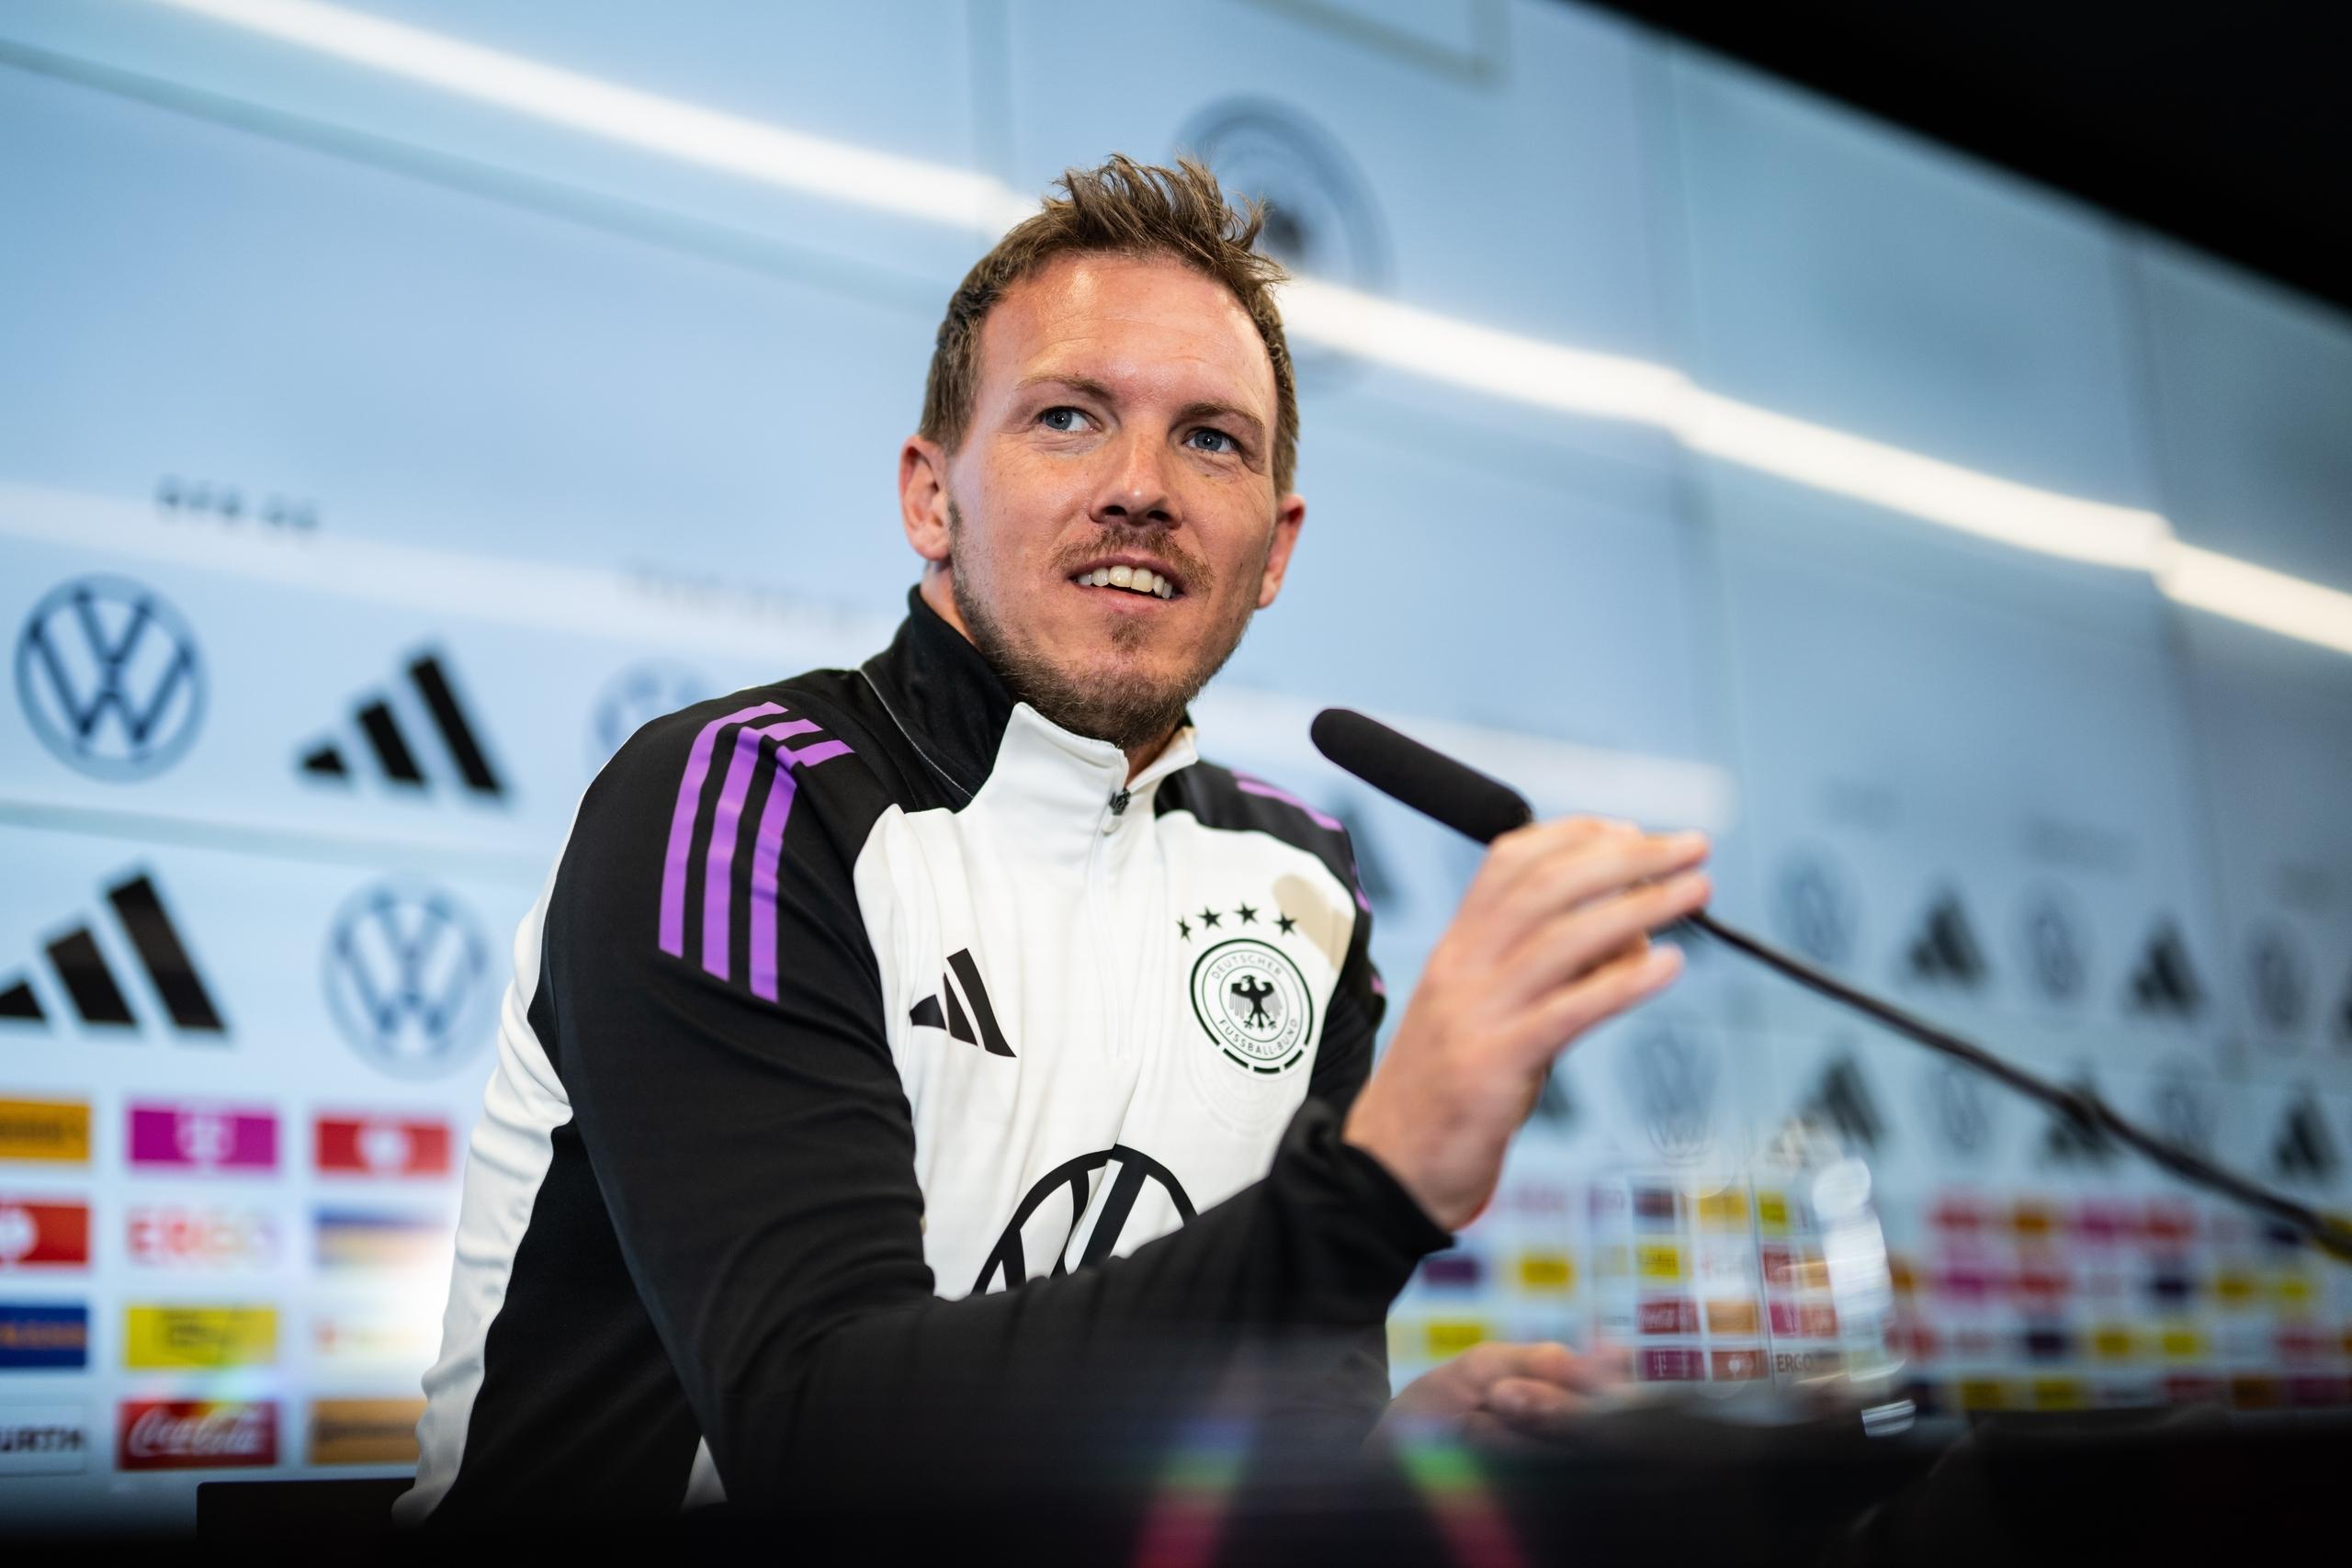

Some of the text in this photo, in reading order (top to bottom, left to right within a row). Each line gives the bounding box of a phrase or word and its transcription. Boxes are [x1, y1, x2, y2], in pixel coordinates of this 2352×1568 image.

[1211, 953, 1282, 980] DEUTSCHER
[1219, 1018, 1298, 1056] FUSSBALL-BUND
[1777, 1353, 1815, 1374] ERGO
